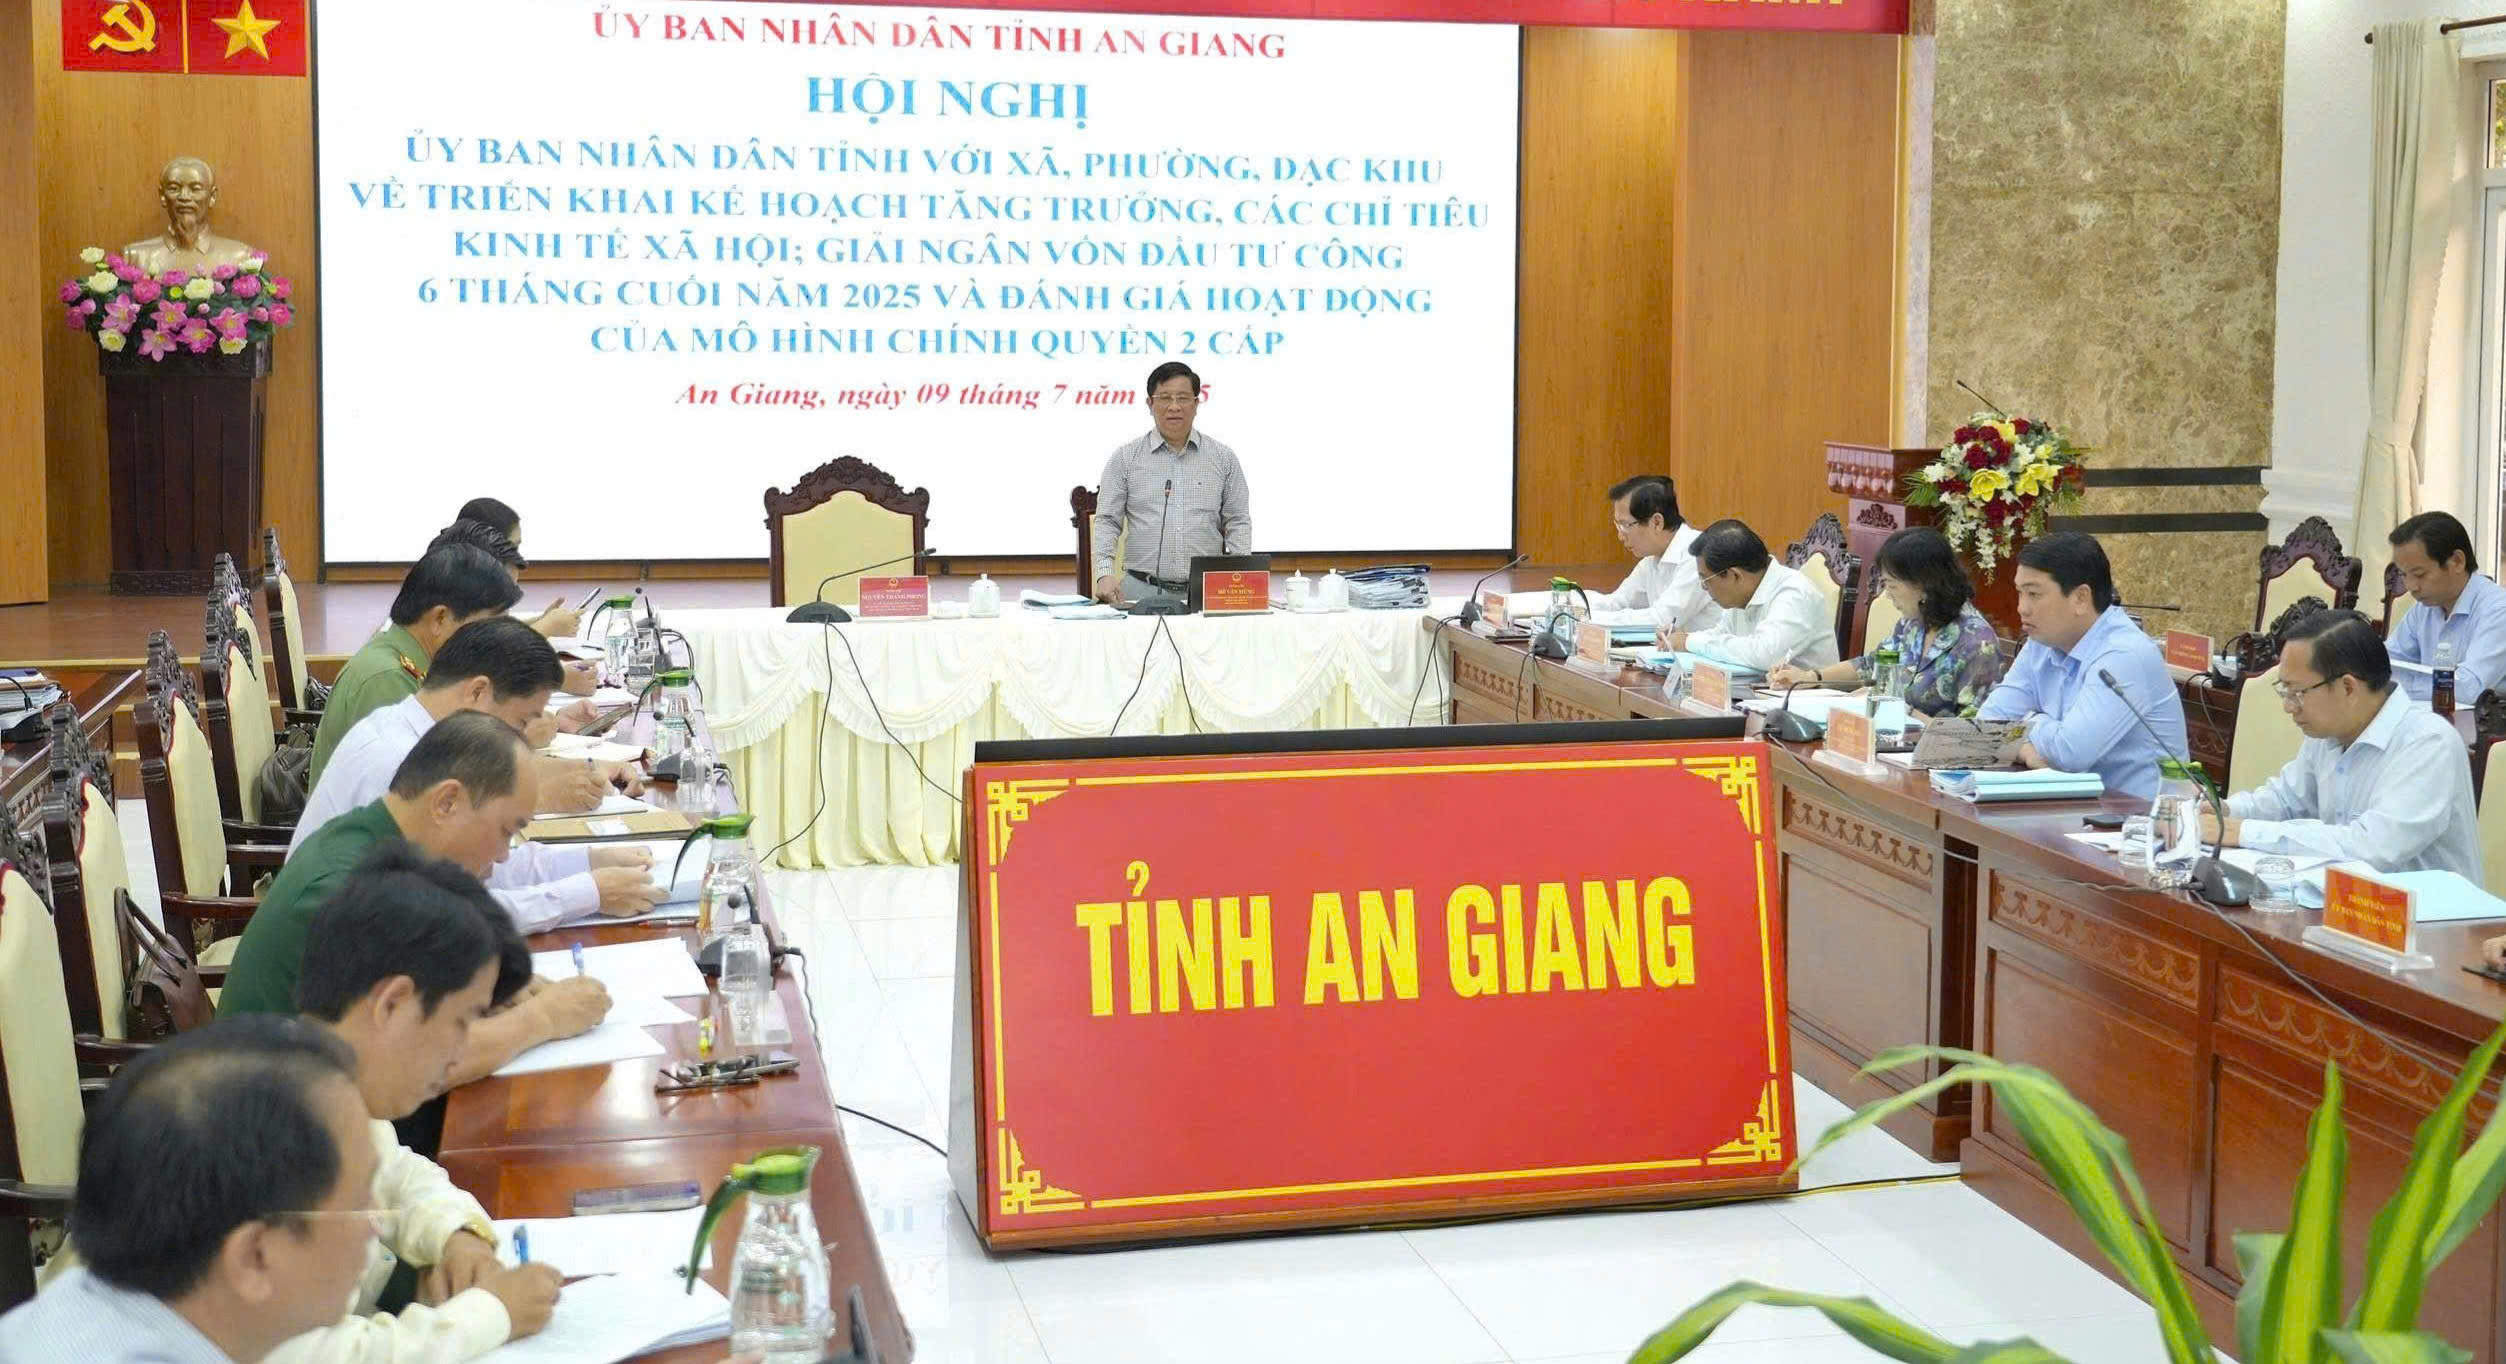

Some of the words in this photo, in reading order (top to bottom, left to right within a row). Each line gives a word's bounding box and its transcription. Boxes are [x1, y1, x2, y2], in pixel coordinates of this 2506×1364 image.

[594, 5, 648, 38] ỦY
[664, 14, 744, 41] BAN
[762, 12, 874, 45] NHÂN
[893, 16, 972, 48] DÂN
[986, 19, 1081, 53] TỈNH
[1094, 30, 1144, 53] AN
[1160, 32, 1284, 58] GIANG
[806, 73, 916, 125] HỘI
[938, 80, 1088, 130] NGHỊ
[406, 129, 462, 163] ỦY
[478, 138, 561, 165] BAN
[579, 134, 695, 168] NHÂN
[712, 137, 795, 170] DÂN
[809, 141, 908, 173] TỈNH
[922, 144, 993, 175] VỚI
[1008, 146, 1071, 179] XÃ,
[1084, 148, 1261, 182] PHƯỜNG,
[1363, 158, 1442, 183] KHU
[568, 188, 673, 215] KHAI
[760, 192, 906, 224] HOẠCH
[920, 189, 1032, 221] TĂNG
[1043, 192, 1223, 225] TRƯỞNG,
[1233, 194, 1313, 224] CÁC
[1324, 196, 1391, 226] CHỈ
[1403, 196, 1488, 228] TIÊU
[454, 232, 561, 258] KINH
[644, 229, 699, 260] XÃ
[715, 233, 803, 268] HỘI;
[815, 231, 904, 264] GIẢI
[919, 232, 1030, 264] NGÂN
[1230, 241, 1286, 267] TƯ
[1294, 237, 1404, 270] CÔNG
[417, 279, 439, 303] 6
[449, 272, 603, 305] THÁNG
[616, 275, 721, 306] CUỐI
[737, 277, 829, 308] NĂM
[843, 283, 921, 309] 2025
[932, 278, 987, 309] VÀ
[999, 278, 1110, 312] ĐÁNH
[1122, 280, 1192, 311] GIÁ
[1206, 288, 1313, 317] HOẠT
[590, 319, 678, 352] CỦA
[691, 320, 759, 352] MÔ
[772, 322, 875, 354] HÌNH
[887, 323, 1017, 354] CHÍNH
[1180, 330, 1196, 354] 2
[675, 384, 719, 404] An
[730, 383, 827, 410] Giang,
[837, 382, 907, 410] ngày
[916, 384, 951, 404] 09
[959, 383, 1041, 410] tháng
[1053, 384, 1068, 404] 7
[1074, 385, 1136, 405] năm
[1076, 861, 1274, 1016] TỈNH
[1304, 889, 1418, 1004] AN
[1447, 877, 1695, 997] GIANG
